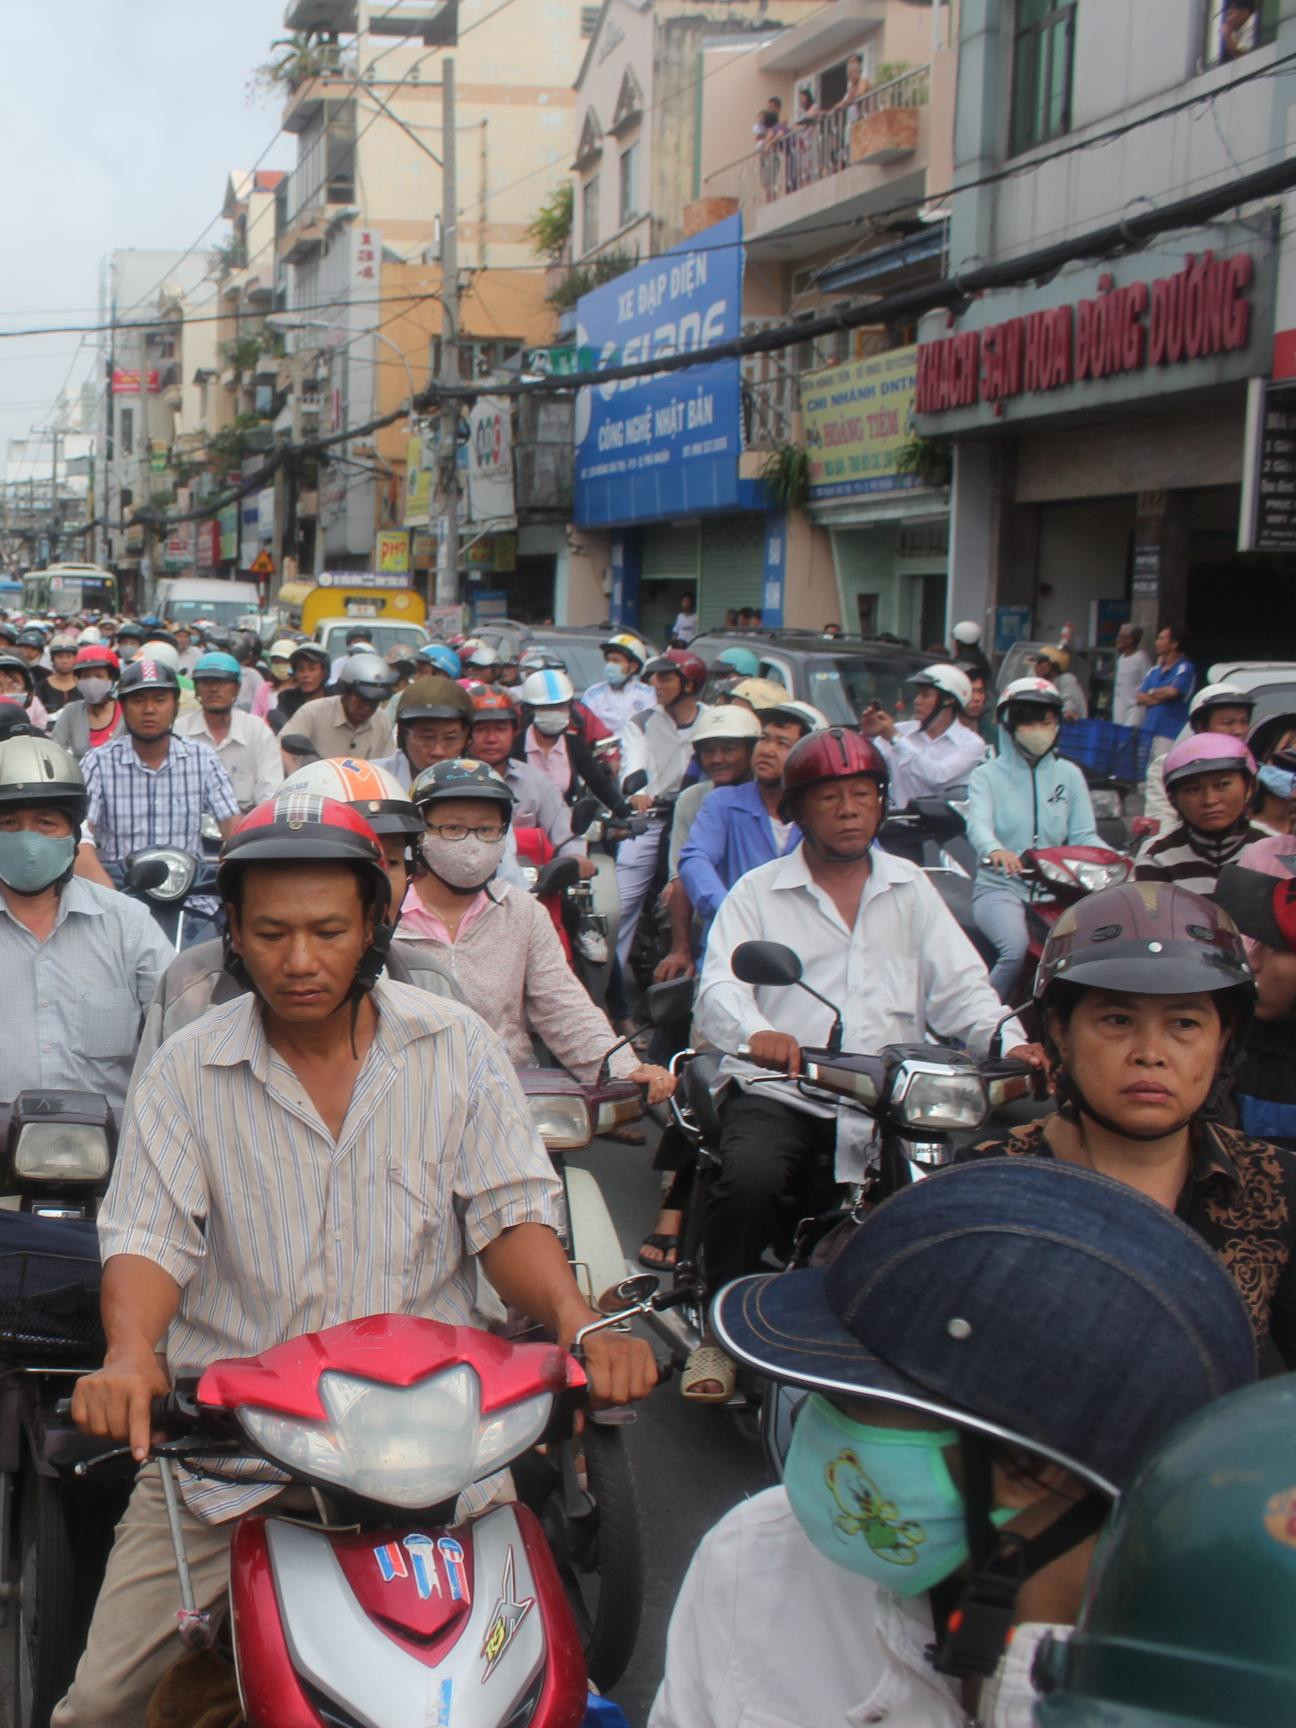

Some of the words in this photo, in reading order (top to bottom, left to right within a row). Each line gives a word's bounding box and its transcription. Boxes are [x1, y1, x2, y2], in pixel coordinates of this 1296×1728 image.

[617, 288, 636, 325] XE
[638, 273, 668, 316] ĐẠP
[670, 252, 707, 299] ĐIỆN
[980, 317, 1023, 417] SẠN
[1024, 304, 1072, 391] HOA
